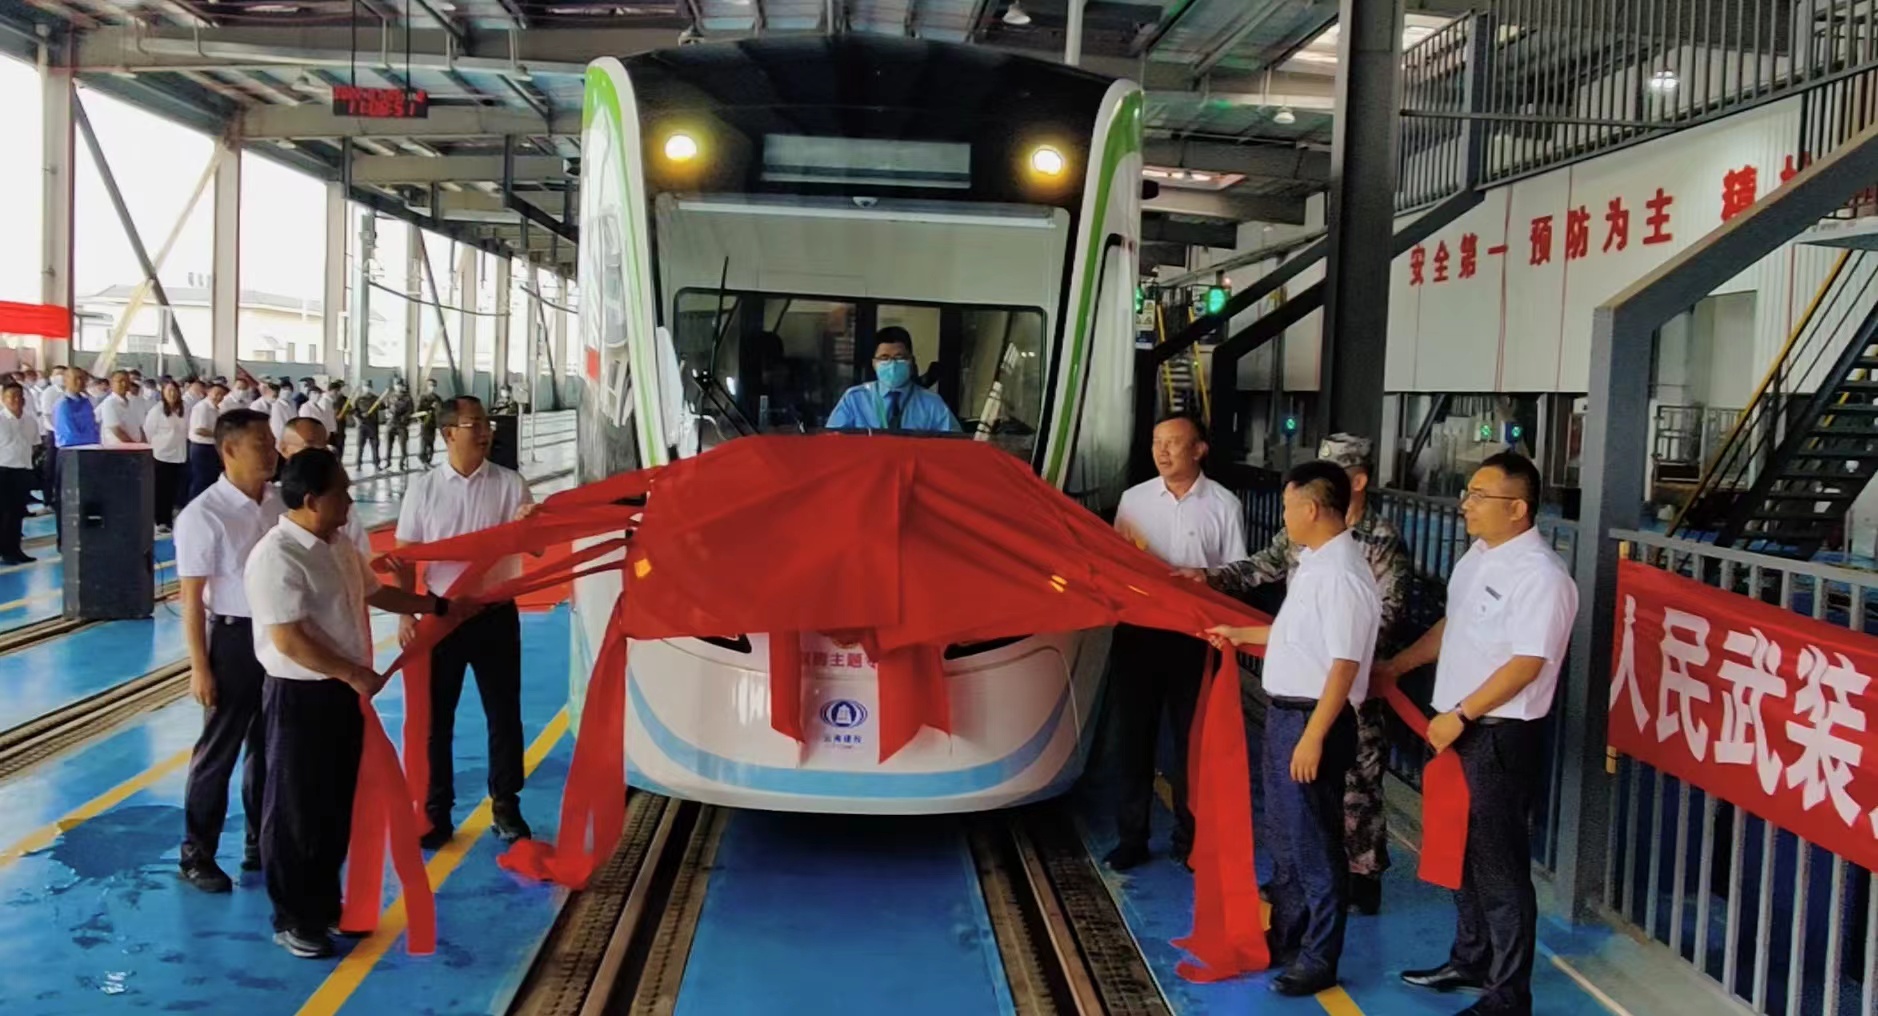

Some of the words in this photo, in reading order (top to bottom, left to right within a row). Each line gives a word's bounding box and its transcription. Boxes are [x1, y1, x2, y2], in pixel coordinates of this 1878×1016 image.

[1410, 232, 1508, 286] 安全第一
[1530, 188, 1673, 266] 预防为主
[1610, 594, 1878, 839] 人民武装
